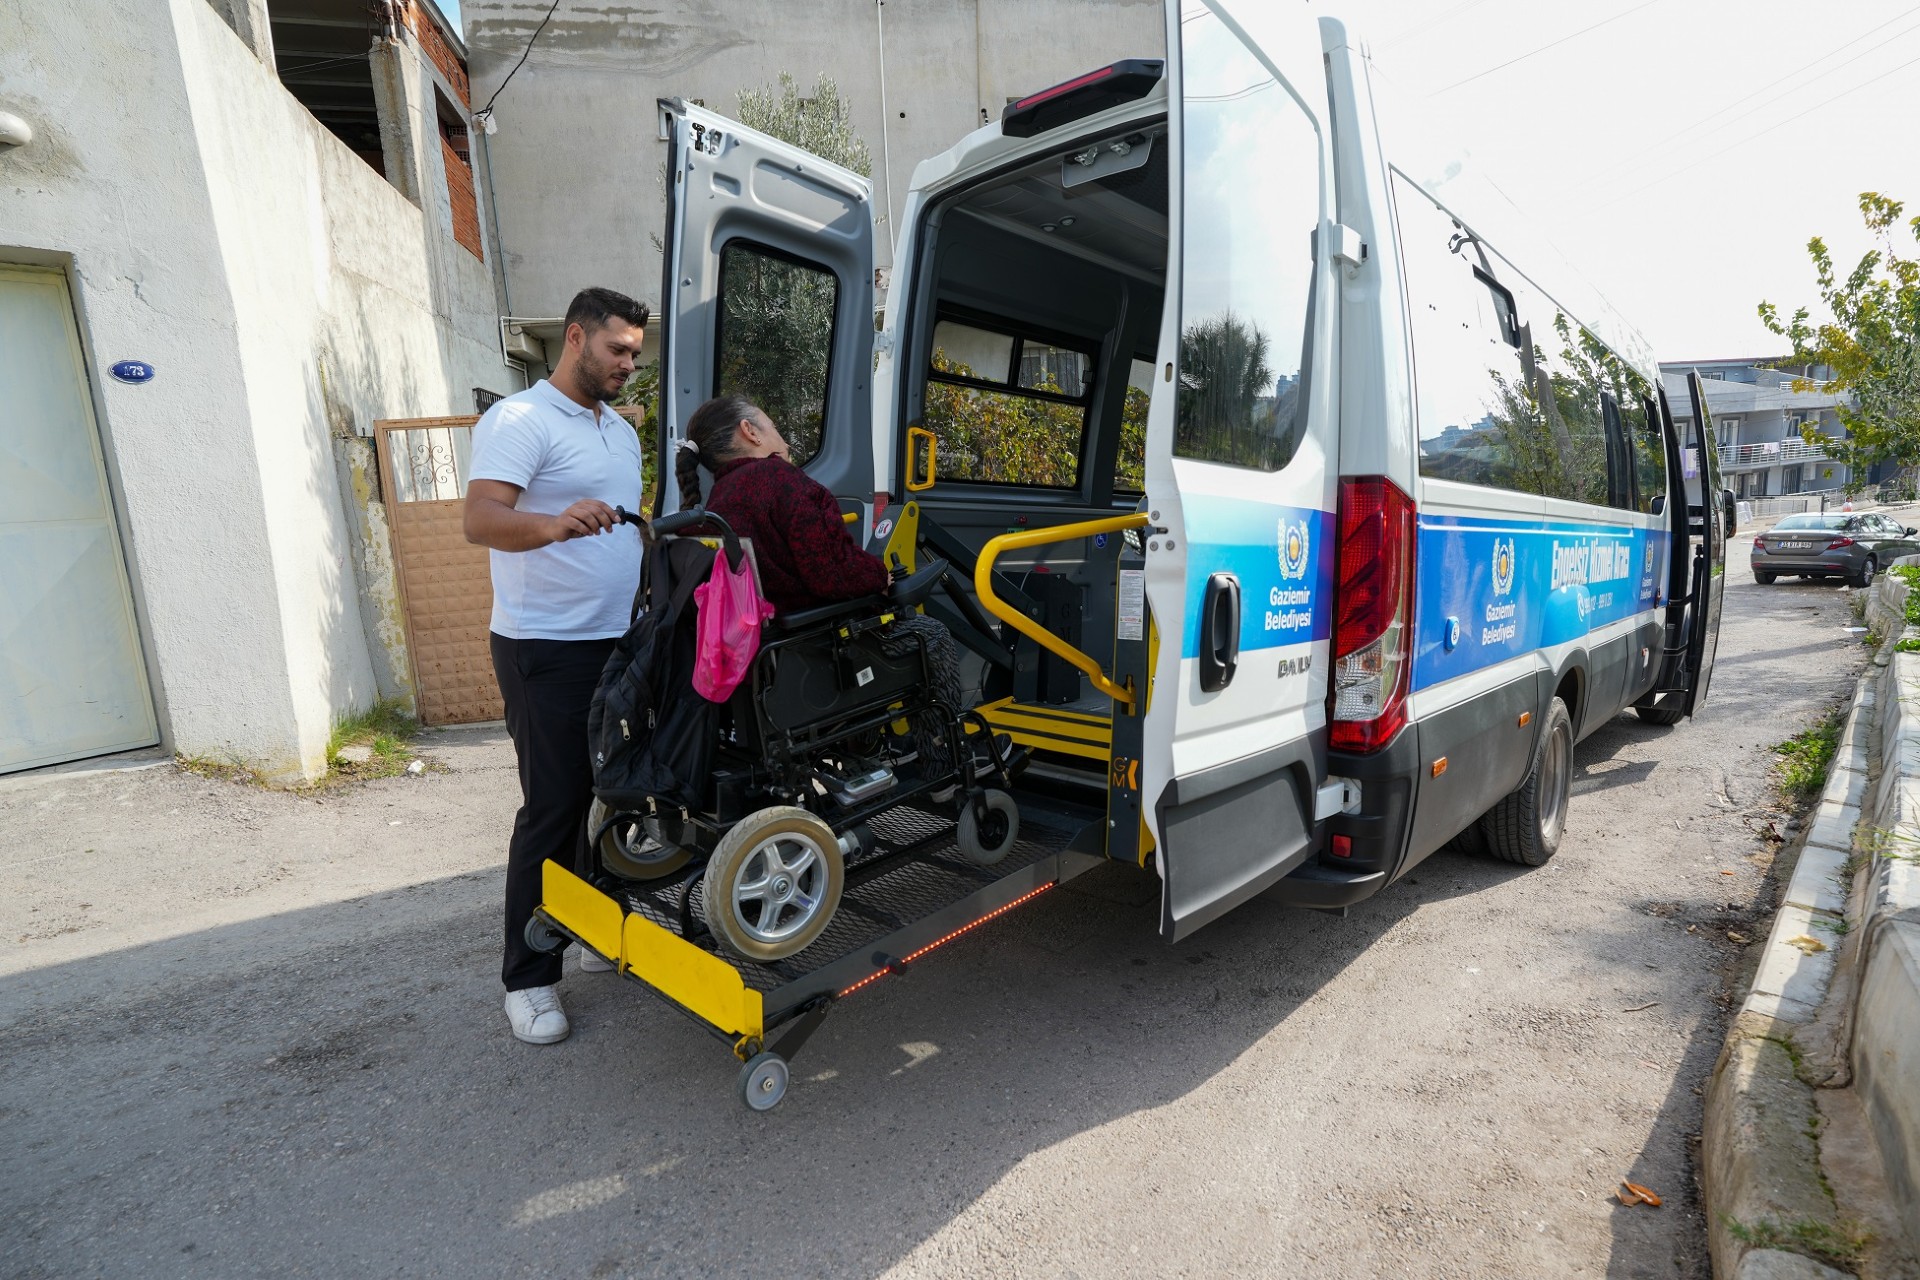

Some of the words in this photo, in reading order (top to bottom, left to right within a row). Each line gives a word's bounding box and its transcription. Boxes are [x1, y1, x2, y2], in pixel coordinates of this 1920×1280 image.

[1270, 586, 1310, 605] Gaziemir
[1265, 608, 1311, 631] Belediyesi
[1486, 600, 1515, 622] Gaziemir
[1482, 622, 1516, 645] Belediyesi
[1278, 655, 1312, 678] DAILY
